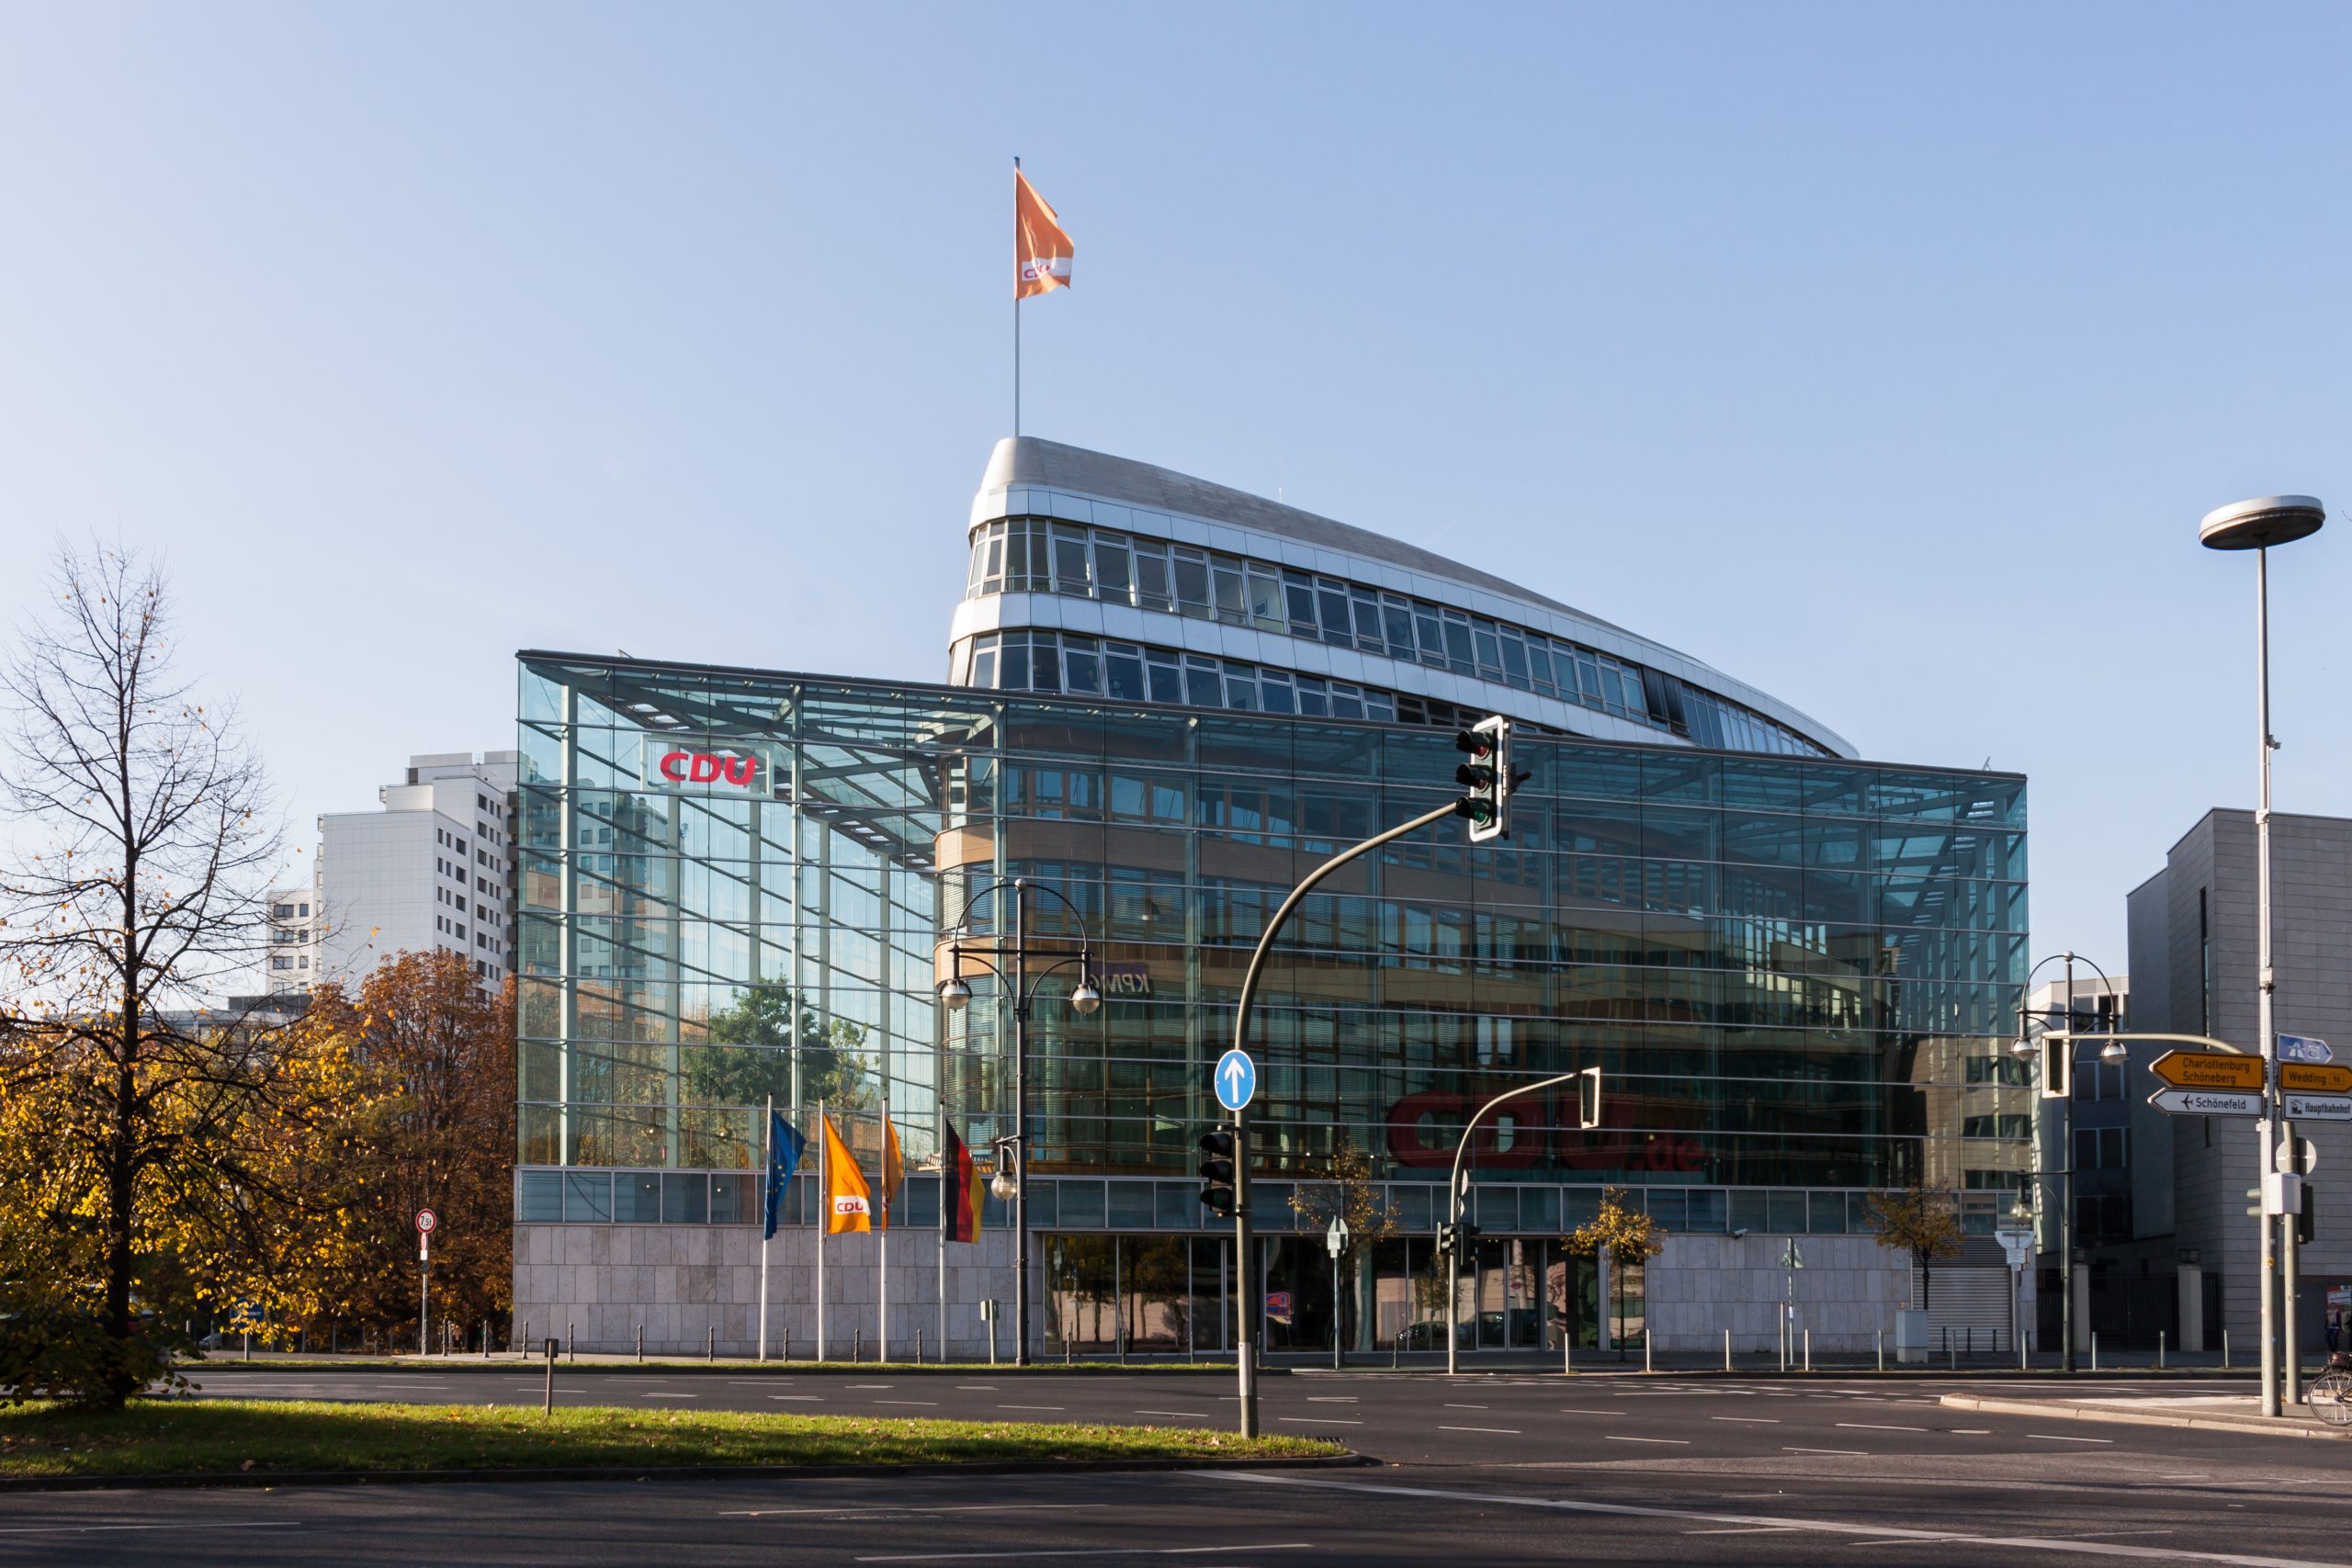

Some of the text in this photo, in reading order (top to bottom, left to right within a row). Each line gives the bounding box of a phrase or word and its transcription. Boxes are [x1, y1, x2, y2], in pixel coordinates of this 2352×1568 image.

[660, 750, 757, 787] CDU
[2182, 1058, 2250, 1074] Charlottenburg
[2182, 1071, 2237, 1084] Schöneberg
[2289, 1071, 2327, 1086] Wedding
[2196, 1097, 2246, 1111] Schönefeld
[2304, 1102, 2352, 1115] Hauptbahnhof
[836, 1201, 864, 1213] CDU
